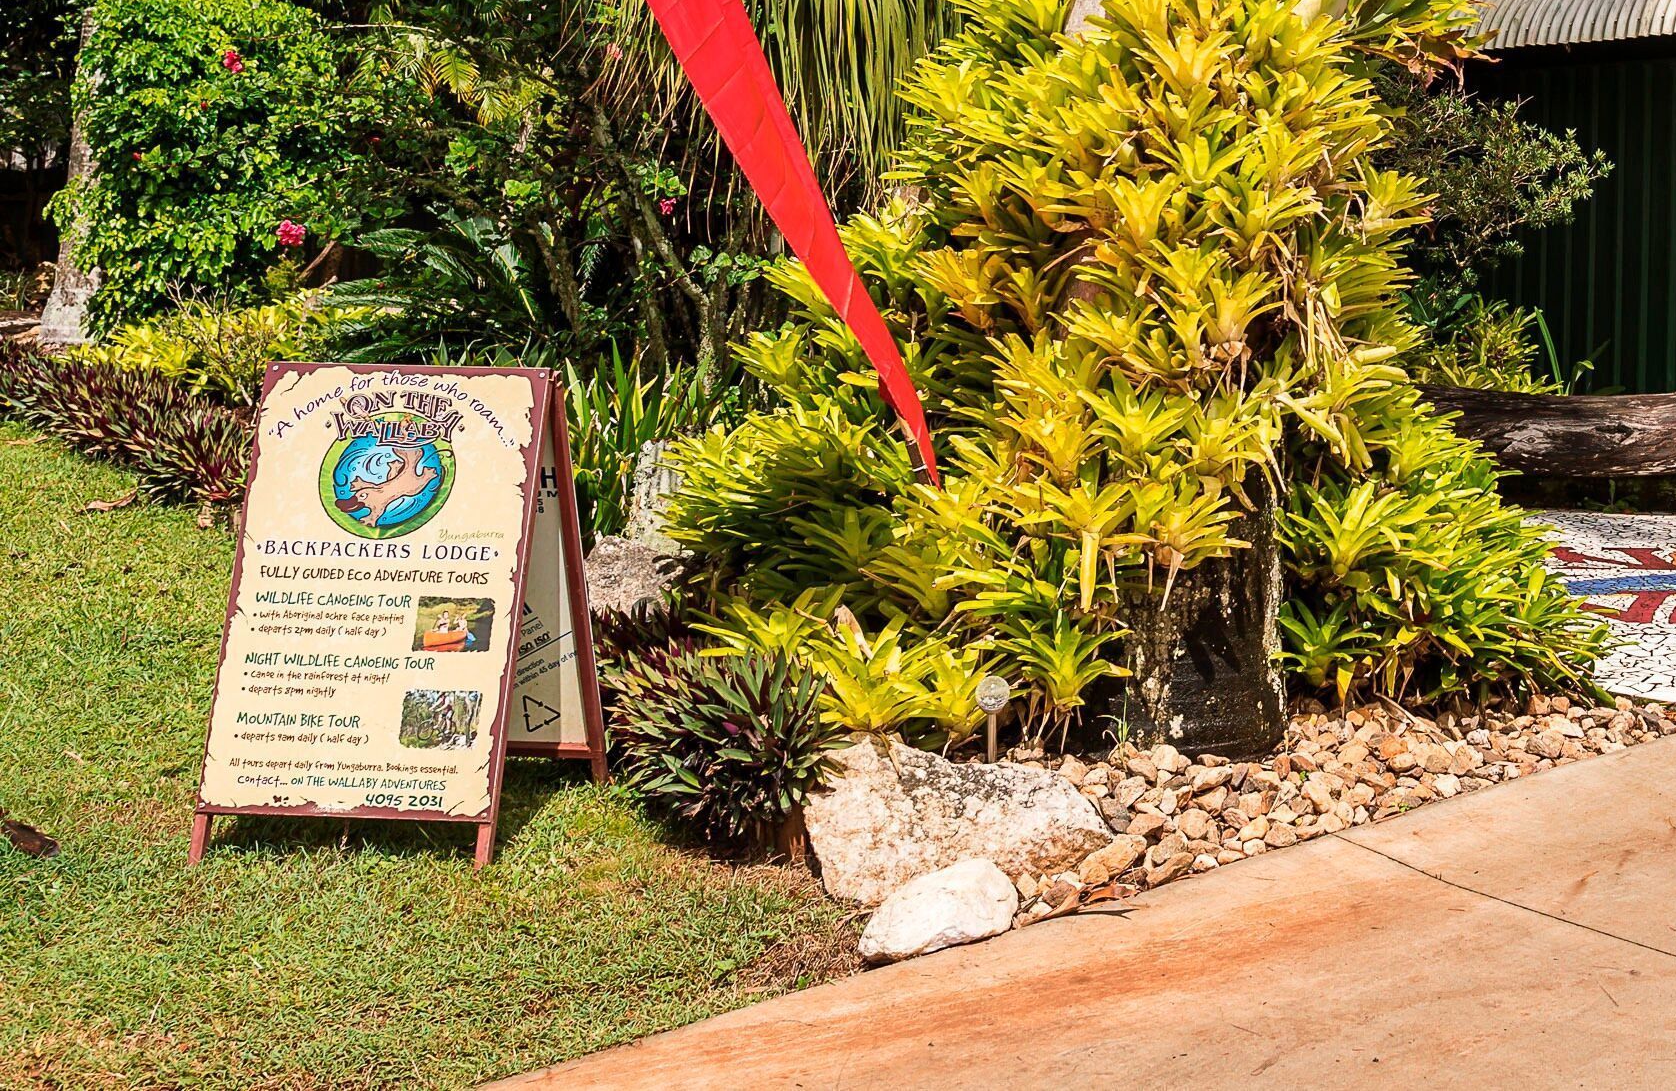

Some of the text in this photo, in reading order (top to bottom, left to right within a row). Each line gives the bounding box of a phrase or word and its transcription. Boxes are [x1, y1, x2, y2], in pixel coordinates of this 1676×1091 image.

[294, 386, 344, 421] home
[349, 376, 375, 392] for
[382, 370, 428, 387] those
[434, 382, 469, 401] who
[345, 390, 459, 423] ON THE
[330, 411, 464, 448] WALLABY
[438, 528, 505, 543] Yungaburra
[264, 540, 491, 561] BACKPACKERS LODGE
[260, 565, 300, 580] FULLY
[302, 568, 345, 580] GUIDED
[374, 569, 443, 583] ADVENTURE
[447, 571, 490, 584] TOURS
[256, 591, 412, 608] WILDLIFE CANOEING TOUR
[260, 609, 405, 625] with Aboriginal ochre face painting
[258, 624, 293, 636] departs
[294, 626, 314, 636] 2pm
[315, 626, 336, 637] daily
[521, 620, 544, 637] Panel
[245, 652, 435, 670] NIGHT WILDLIFE CANOEING TOUR
[276, 670, 284, 678] in
[287, 670, 302, 681] the
[304, 671, 349, 683] rainforest
[351, 673, 361, 684] at
[364, 673, 390, 684] night!
[248, 685, 336, 698] departs 8pm nightly
[236, 712, 361, 728] MOUNTAIN BIKE TOUR
[240, 732, 275, 743] departs
[277, 733, 295, 742] 9am
[297, 733, 318, 744] daily
[229, 758, 459, 776] All tours depart daily from Yungaburra. Bookings essential.
[291, 776, 304, 785] ON
[306, 775, 326, 787] THE
[328, 777, 379, 789] WALLABY
[380, 779, 447, 791] ADVENTURES
[365, 794, 443, 807] 4095 2031
